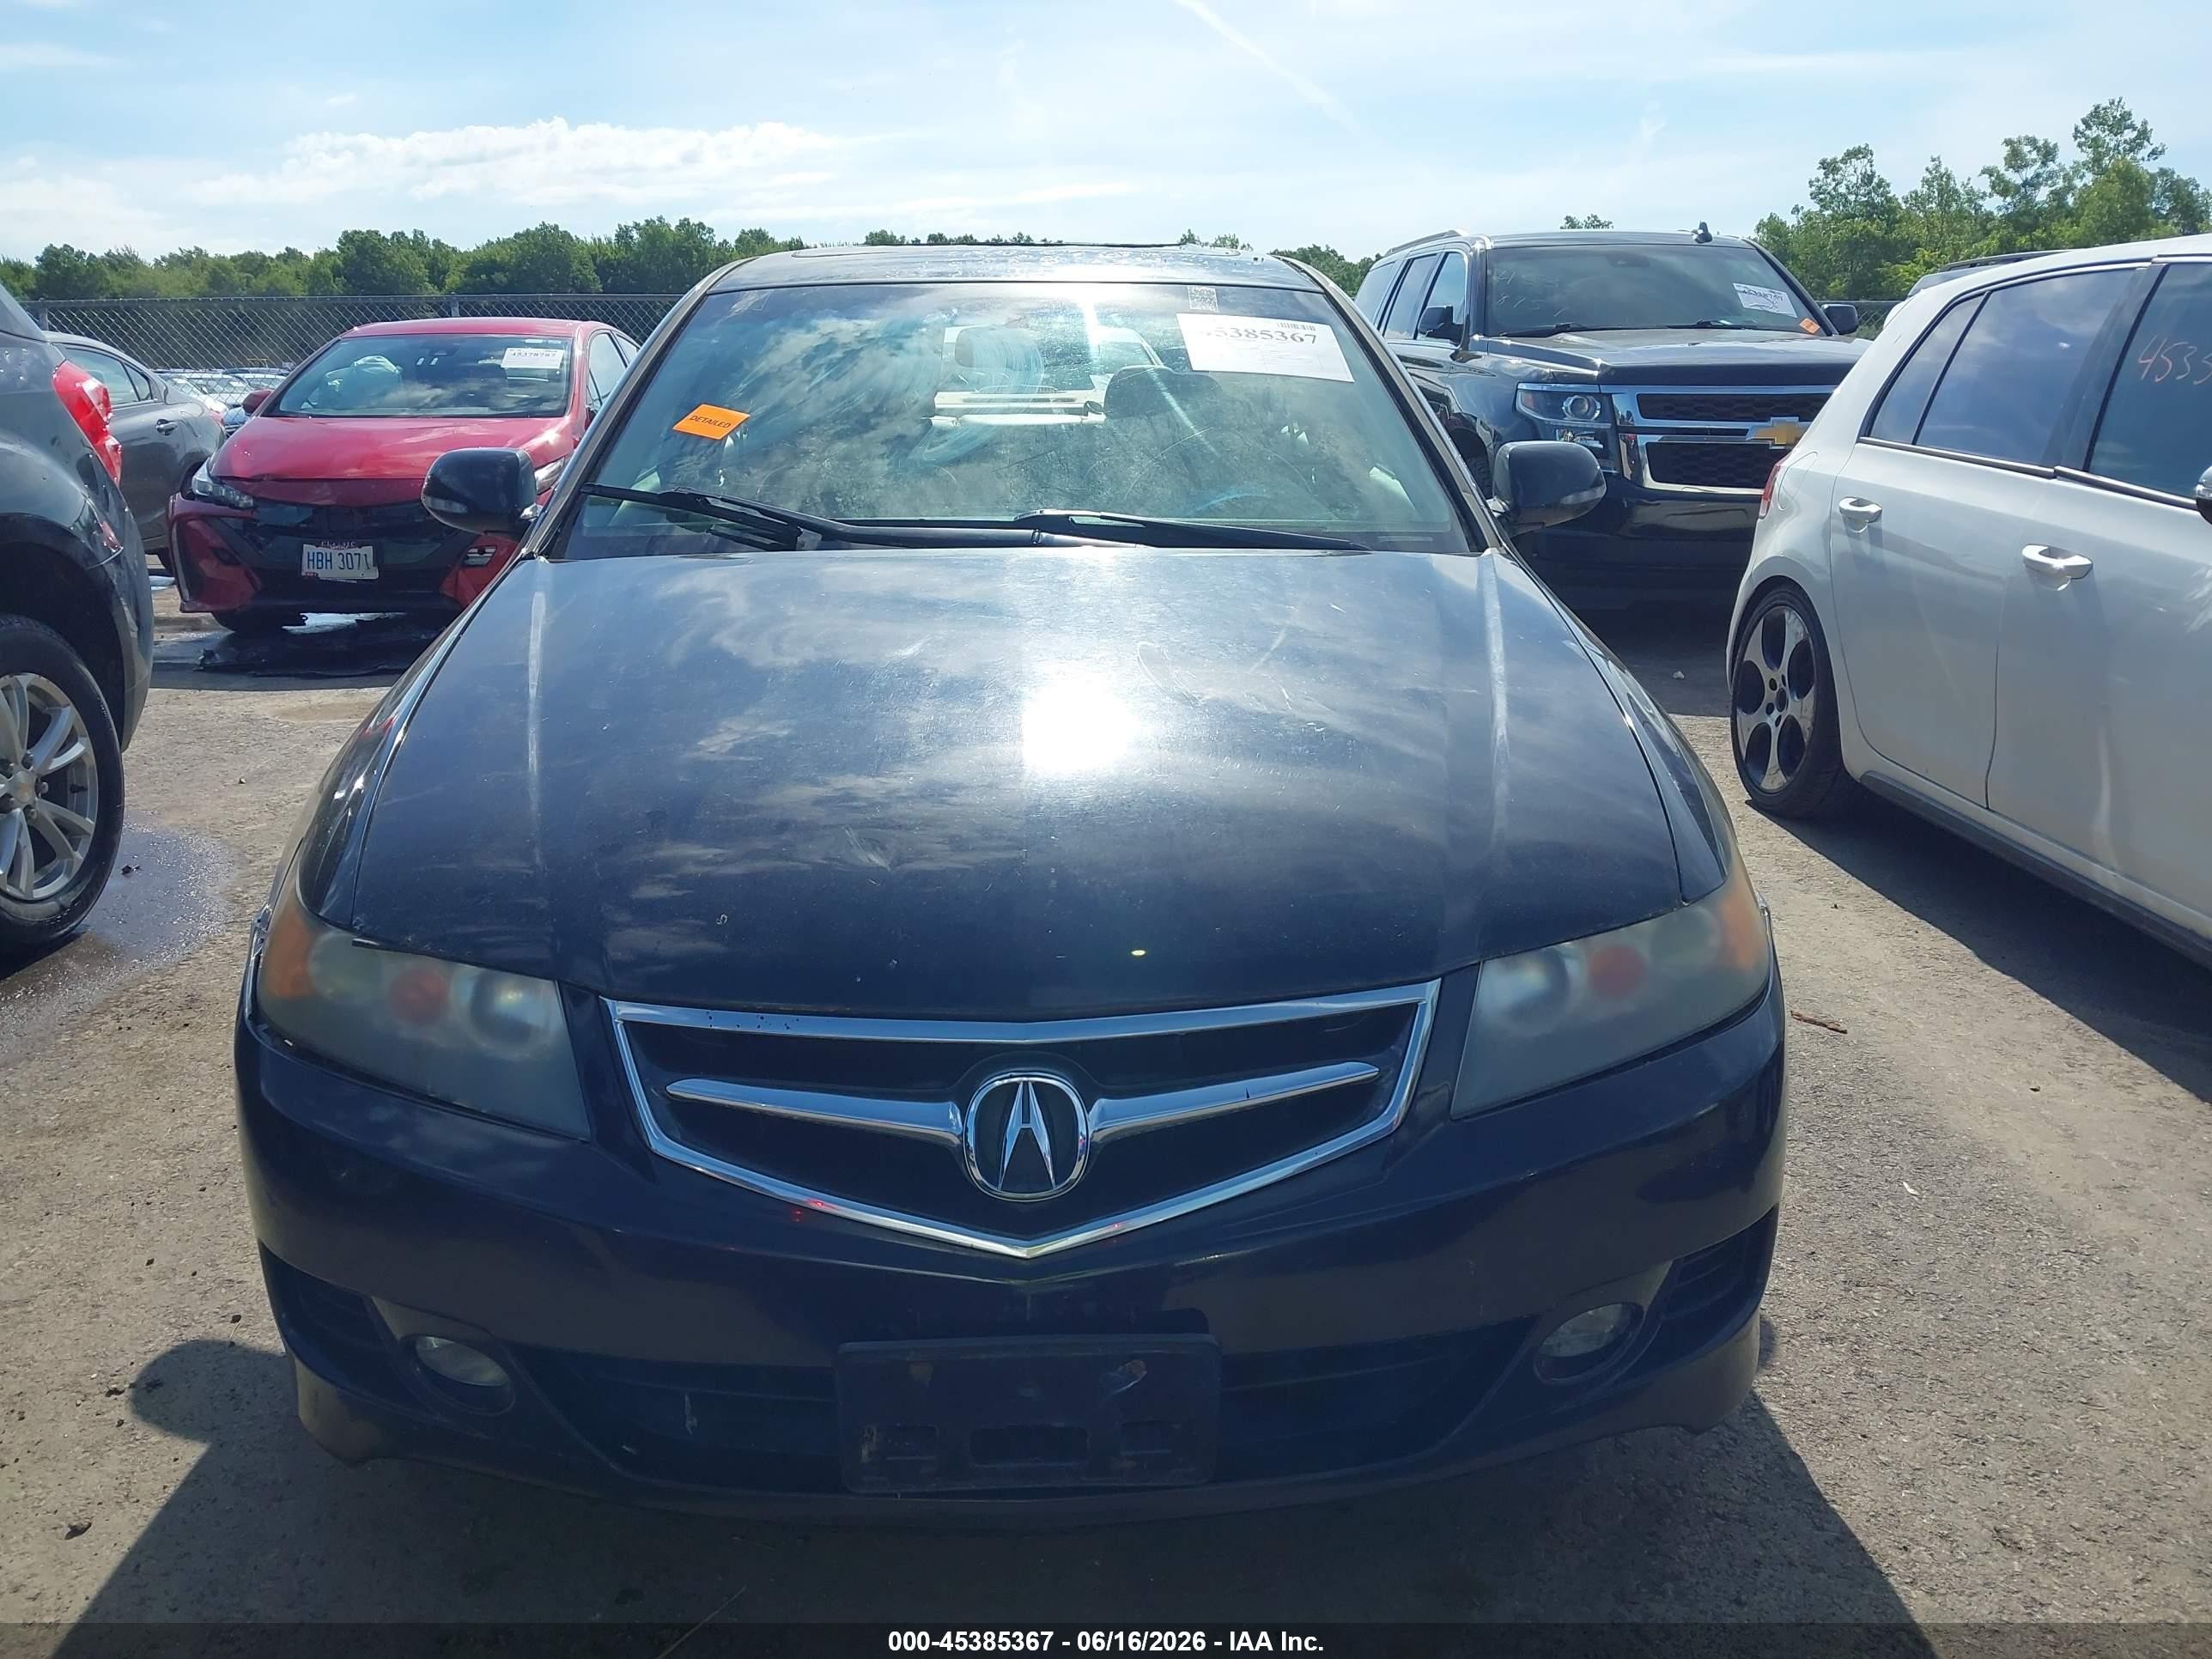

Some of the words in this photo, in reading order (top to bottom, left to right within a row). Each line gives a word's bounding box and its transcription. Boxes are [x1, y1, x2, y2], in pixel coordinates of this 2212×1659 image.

[689, 415, 732, 428] DETAILED
[307, 551, 333, 570] HBH
[337, 552, 371, 570] 3071
